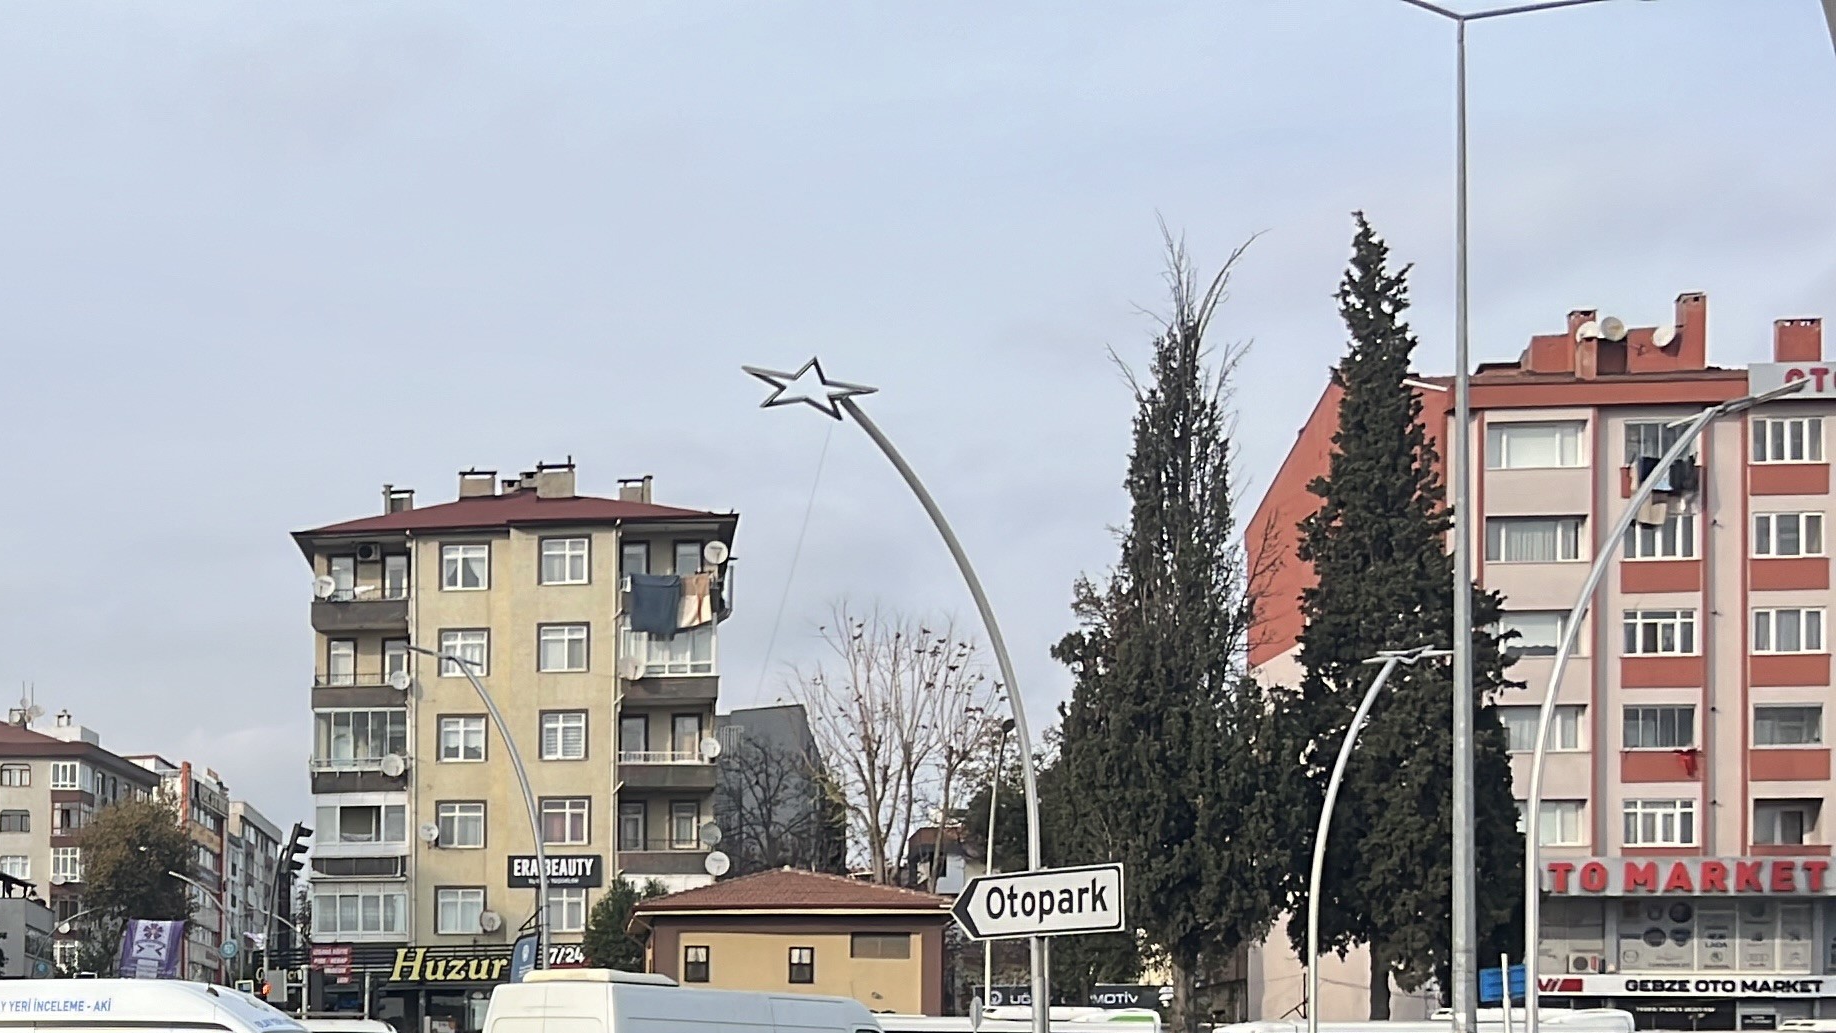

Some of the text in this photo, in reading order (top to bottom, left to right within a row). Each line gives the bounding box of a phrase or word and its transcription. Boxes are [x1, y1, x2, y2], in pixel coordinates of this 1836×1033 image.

[1784, 368, 1836, 392] OT
[513, 858, 594, 877] ERA BEAUTY
[1548, 860, 1829, 892] TO MARKET
[986, 877, 1108, 924] Otopark
[389, 947, 585, 981] Huzur 7/24
[1625, 979, 1824, 992] GEBZE OTO MARKET
[9, 997, 31, 1012] YERİ
[33, 998, 85, 1012] İNCELEME
[93, 997, 112, 1012] AKİ
[1010, 990, 1139, 1004] UĞ MOTİV
